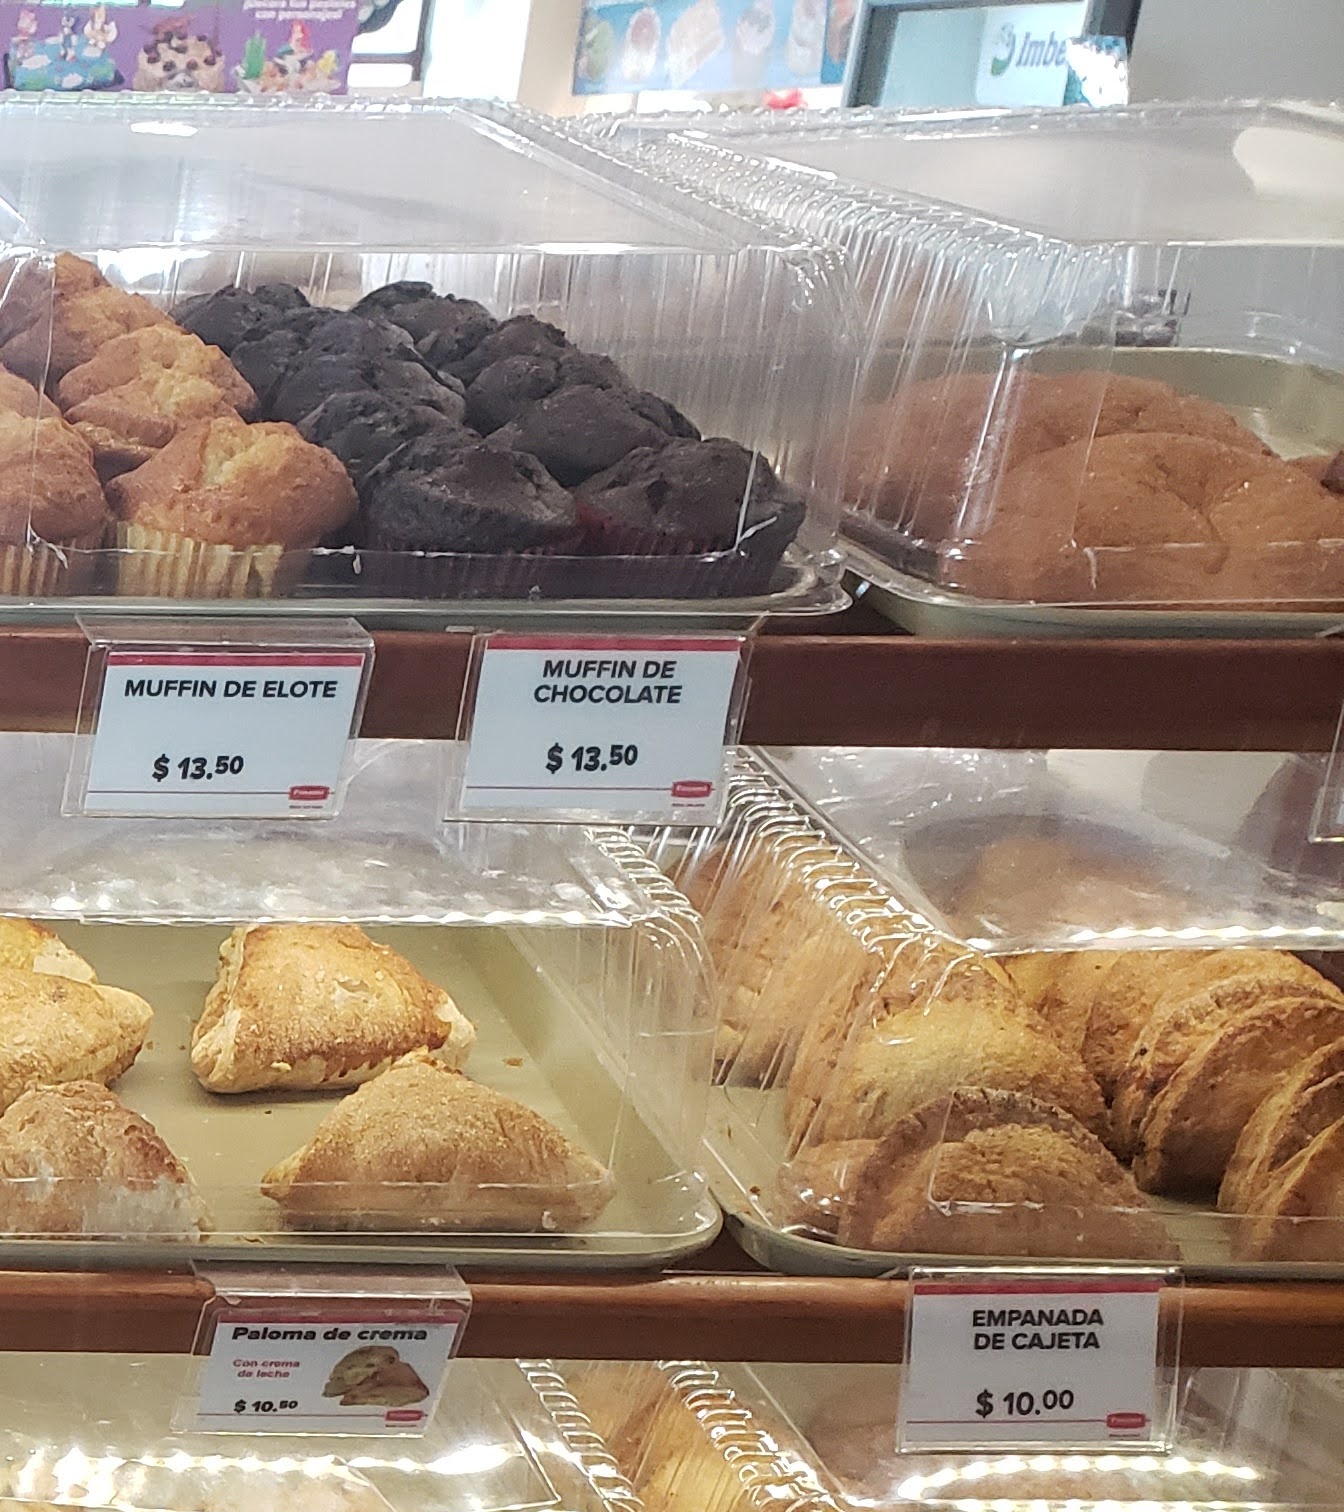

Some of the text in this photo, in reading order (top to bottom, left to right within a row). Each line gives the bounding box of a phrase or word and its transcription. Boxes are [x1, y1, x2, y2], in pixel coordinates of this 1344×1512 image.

[542, 660, 677, 678] MUFFIN DE
[124, 679, 338, 698] MUFFIN DE ELOTE
[534, 684, 683, 704] CHOCOLATE
[546, 743, 639, 774] $ 13.50
[152, 754, 244, 782] $ 13.50
[972, 1309, 1104, 1327] EMPANADA
[231, 1327, 428, 1340] Paloma de crema
[974, 1332, 1100, 1350] DE CAJETA
[233, 1359, 257, 1368] Con
[975, 1389, 1074, 1418] $ 10.00
